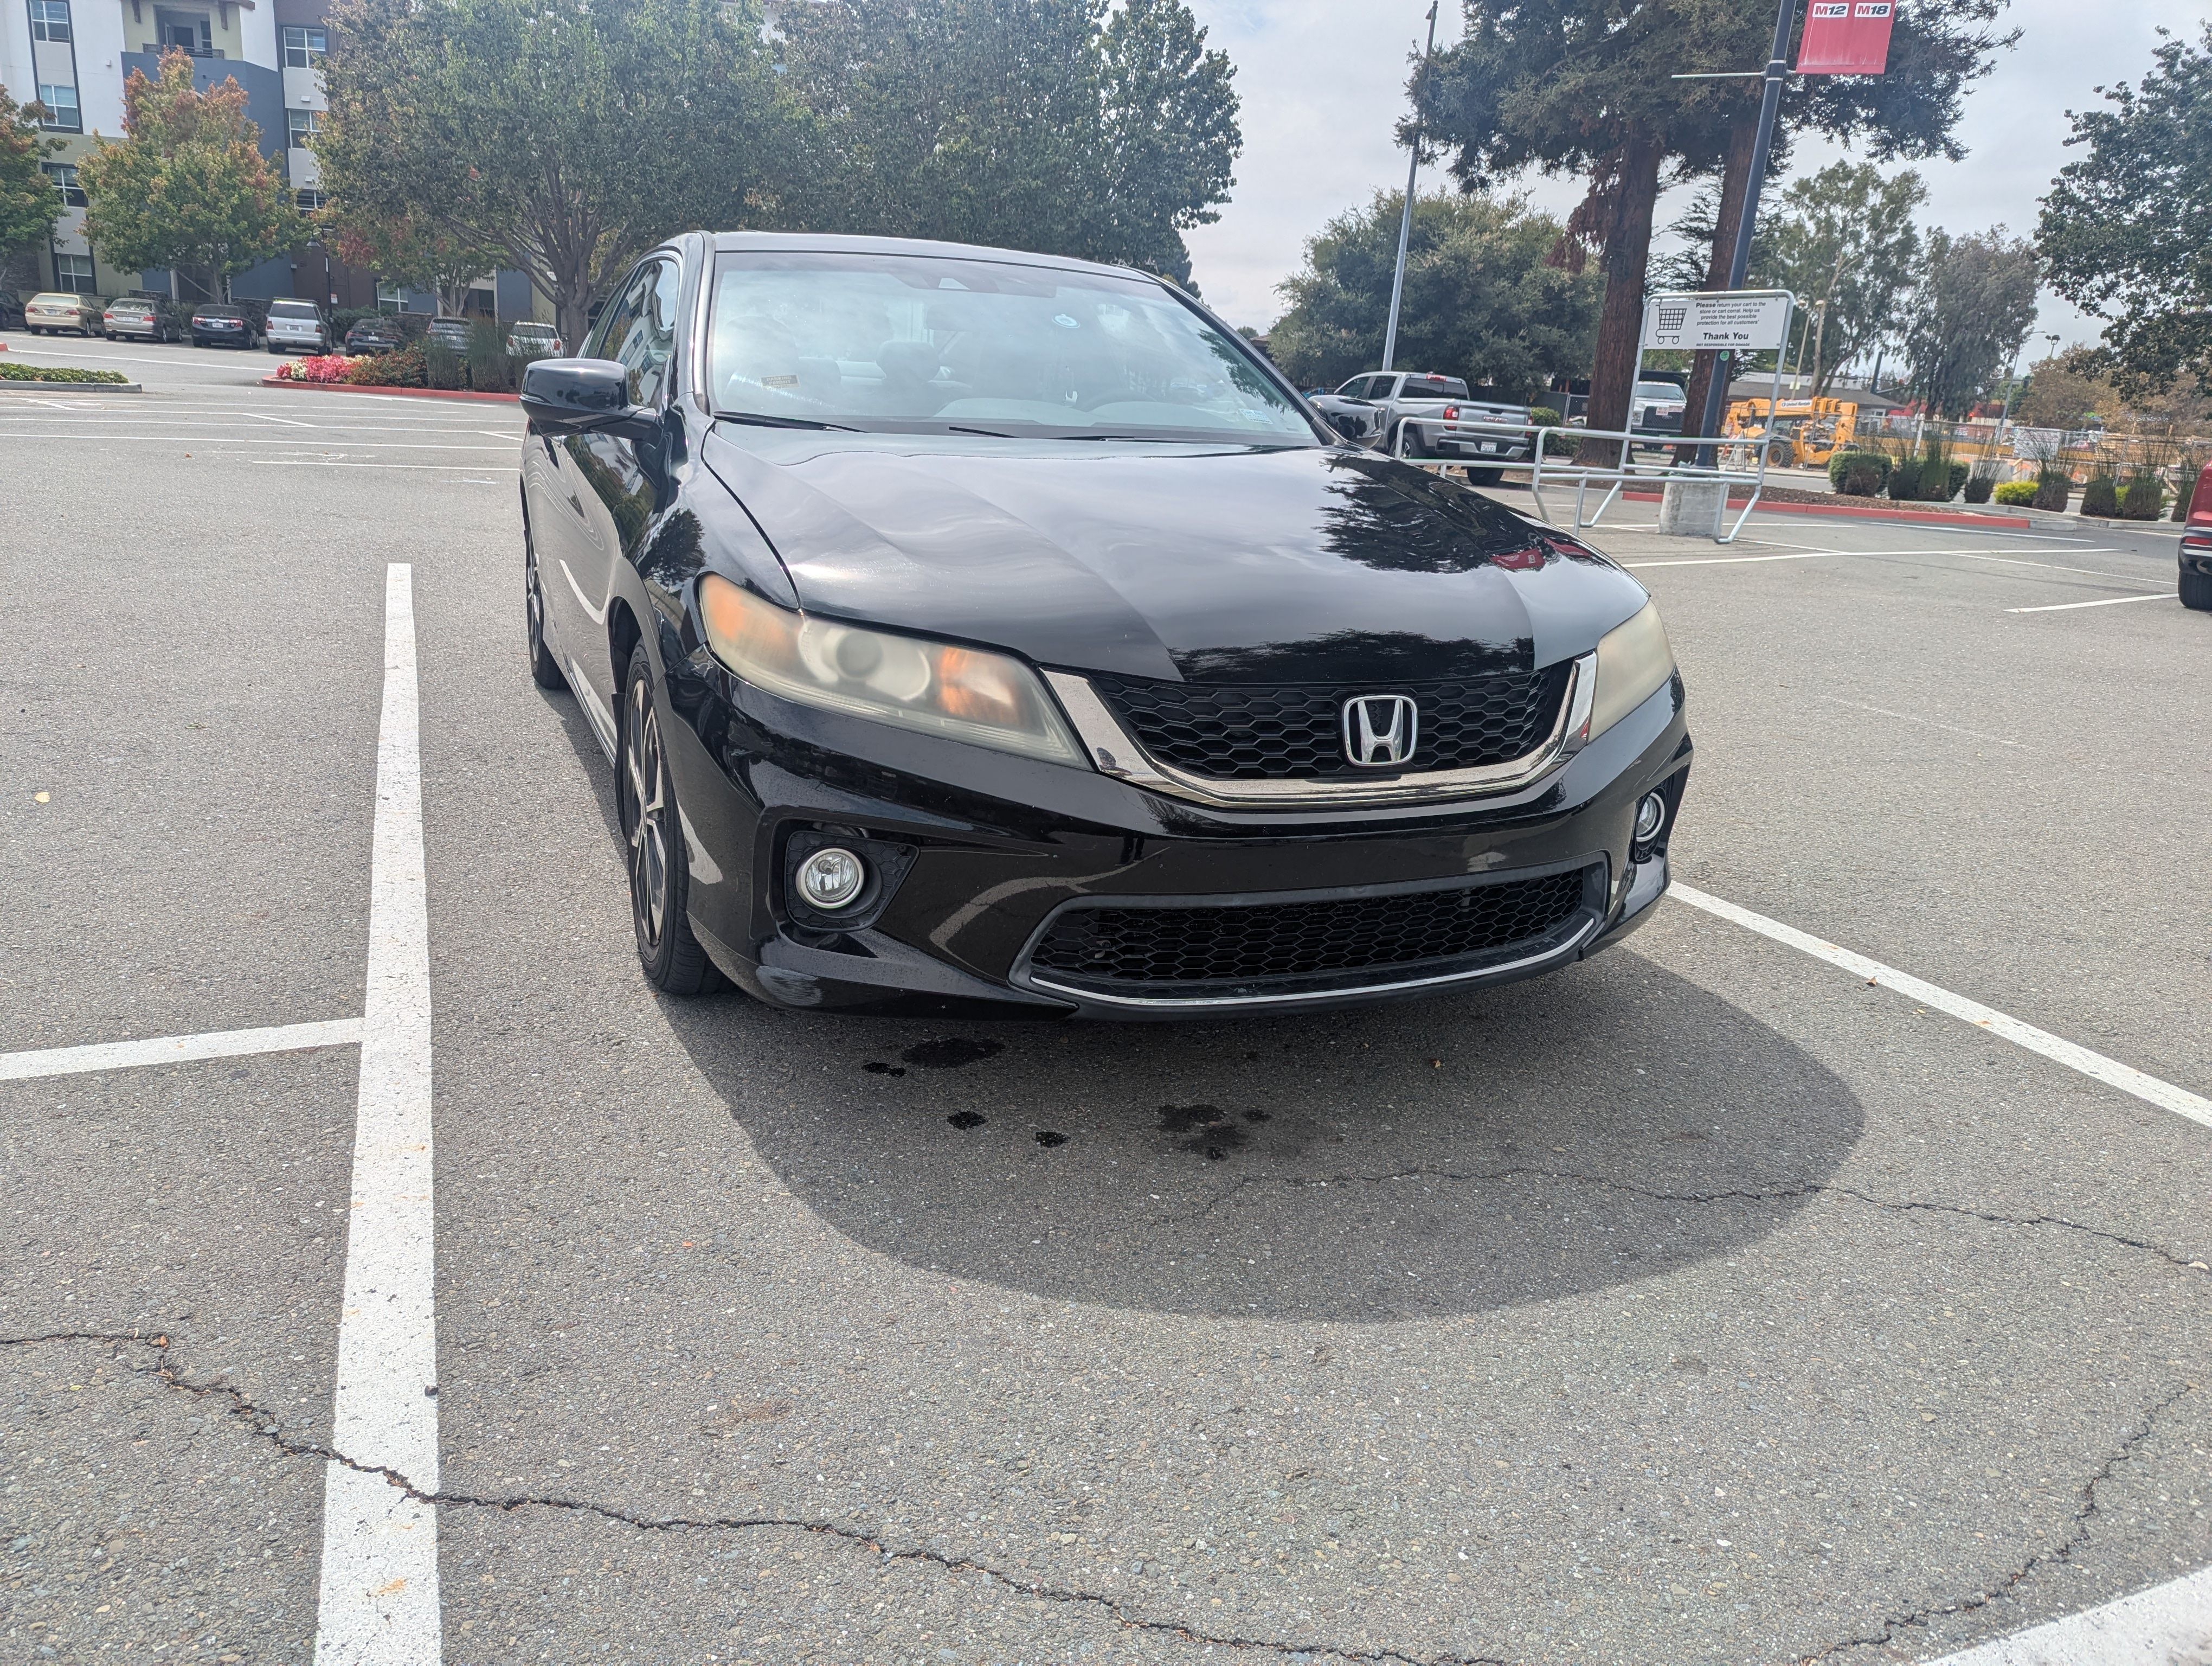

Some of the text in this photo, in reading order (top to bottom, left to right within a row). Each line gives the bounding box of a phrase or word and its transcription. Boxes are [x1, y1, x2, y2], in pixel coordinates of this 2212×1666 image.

[1815, 5, 1889, 15] M12 M18
[1703, 332, 1749, 340] Thank You
